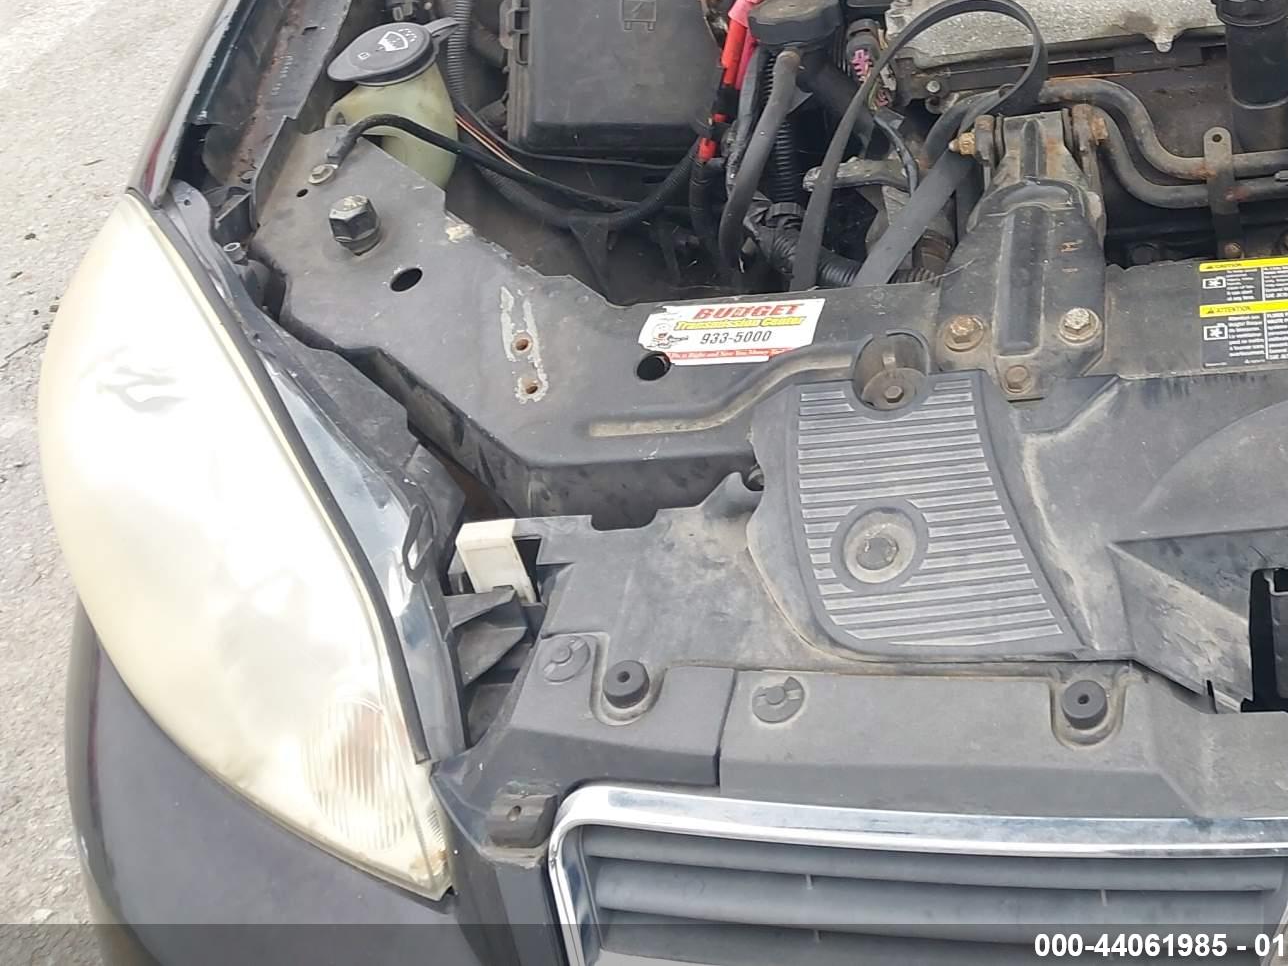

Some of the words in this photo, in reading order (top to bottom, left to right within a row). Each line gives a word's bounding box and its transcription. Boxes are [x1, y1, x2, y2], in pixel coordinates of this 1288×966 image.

[693, 304, 804, 320] BUDGET
[1216, 306, 1251, 314] ATTENTION
[674, 319, 760, 330] Transmission
[761, 316, 806, 327] Center
[700, 330, 772, 345] 933-5000
